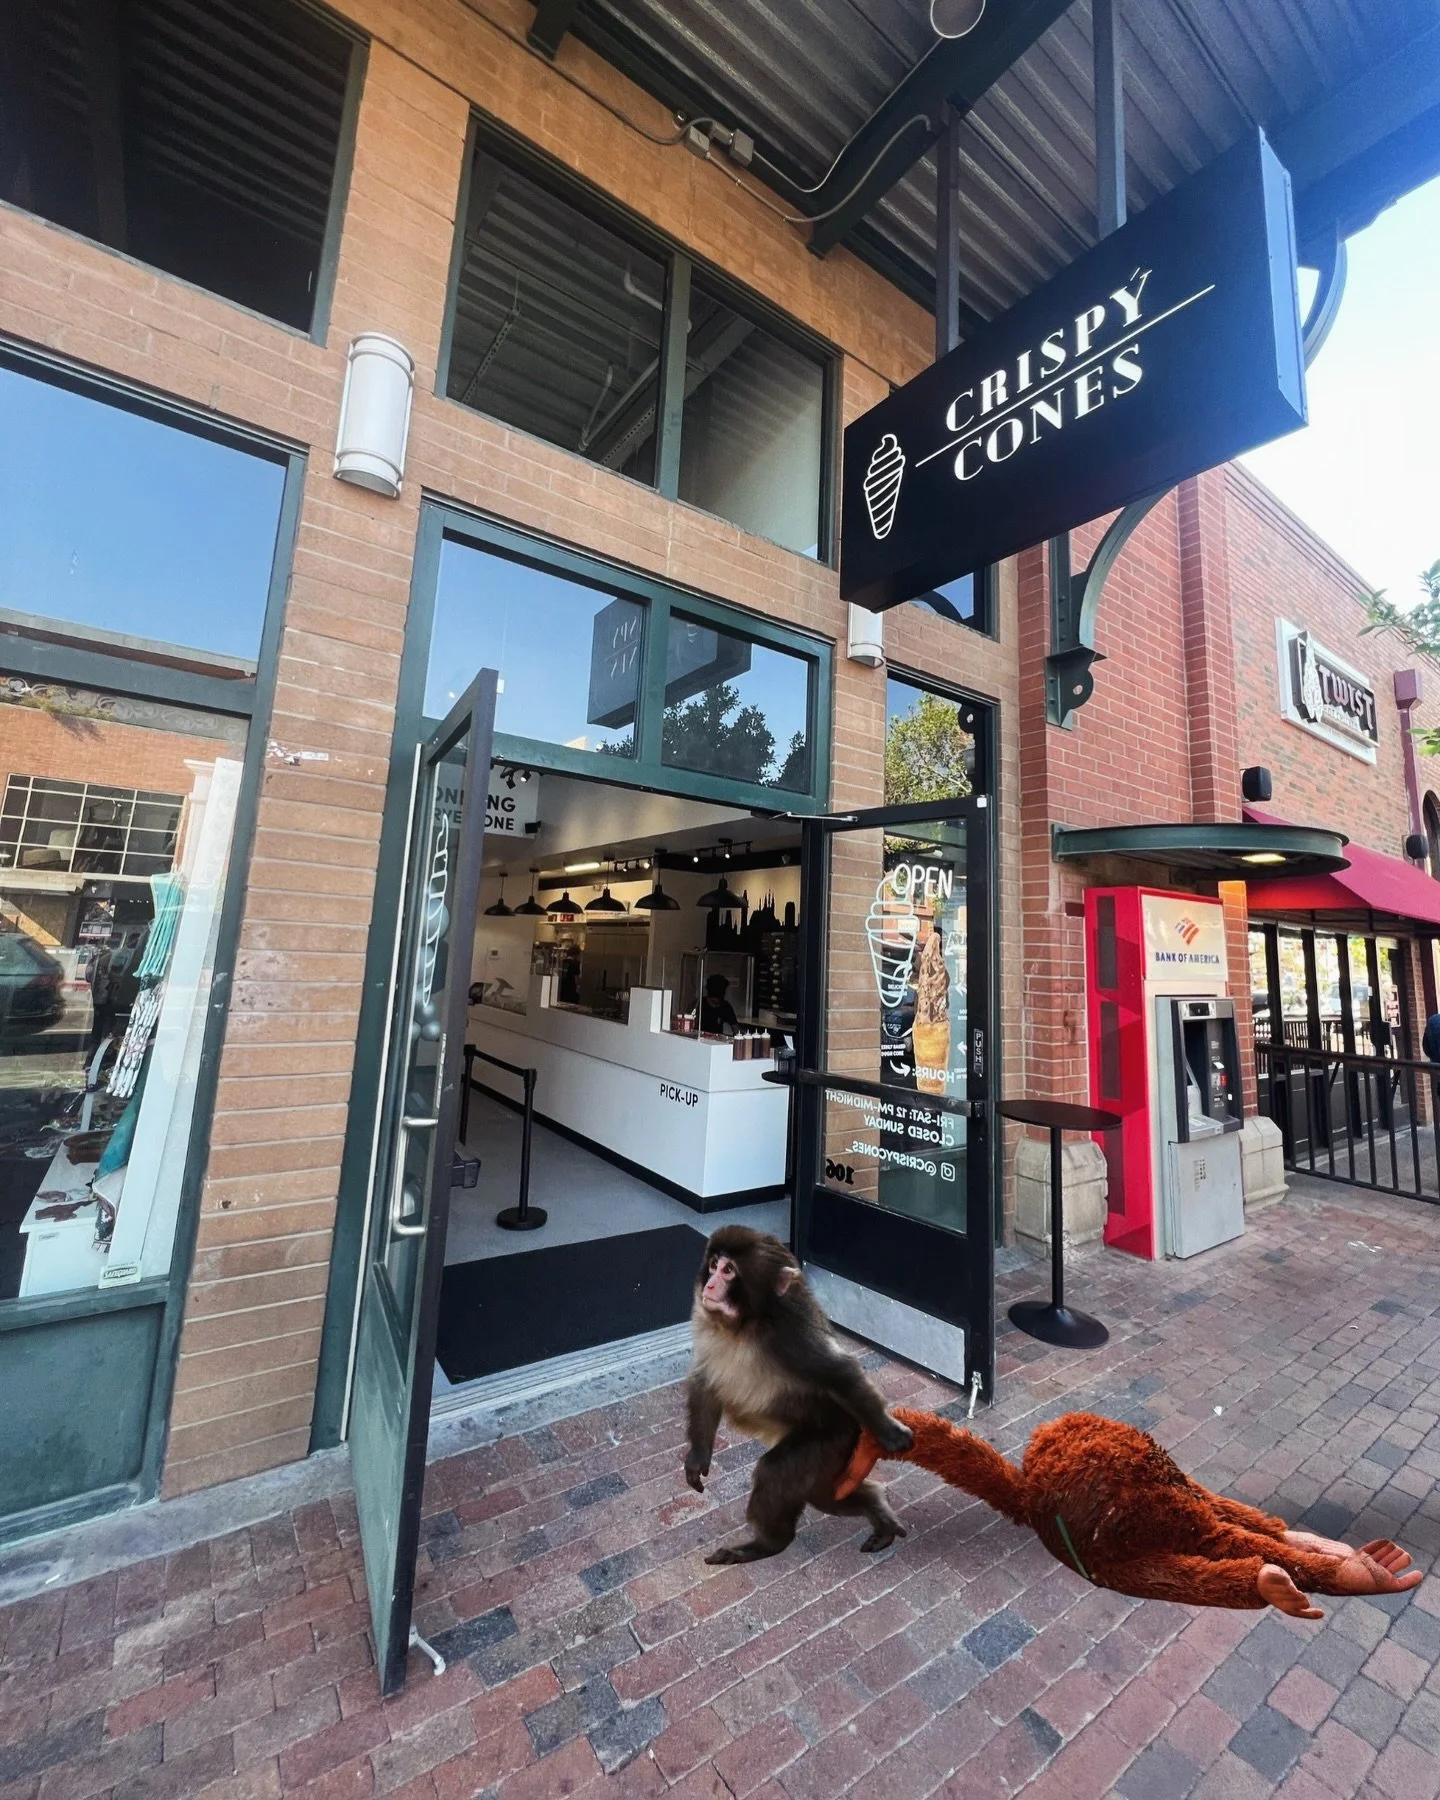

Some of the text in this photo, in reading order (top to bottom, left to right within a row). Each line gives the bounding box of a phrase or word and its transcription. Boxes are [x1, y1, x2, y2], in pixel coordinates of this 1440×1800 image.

[953, 343, 1144, 481] CONES
[1319, 664, 1374, 730] TWIST
[893, 863, 953, 899] OPEN
[1155, 952, 1220, 964] BANK OF AMERICA
[660, 1083, 699, 1107] PICK-UP
